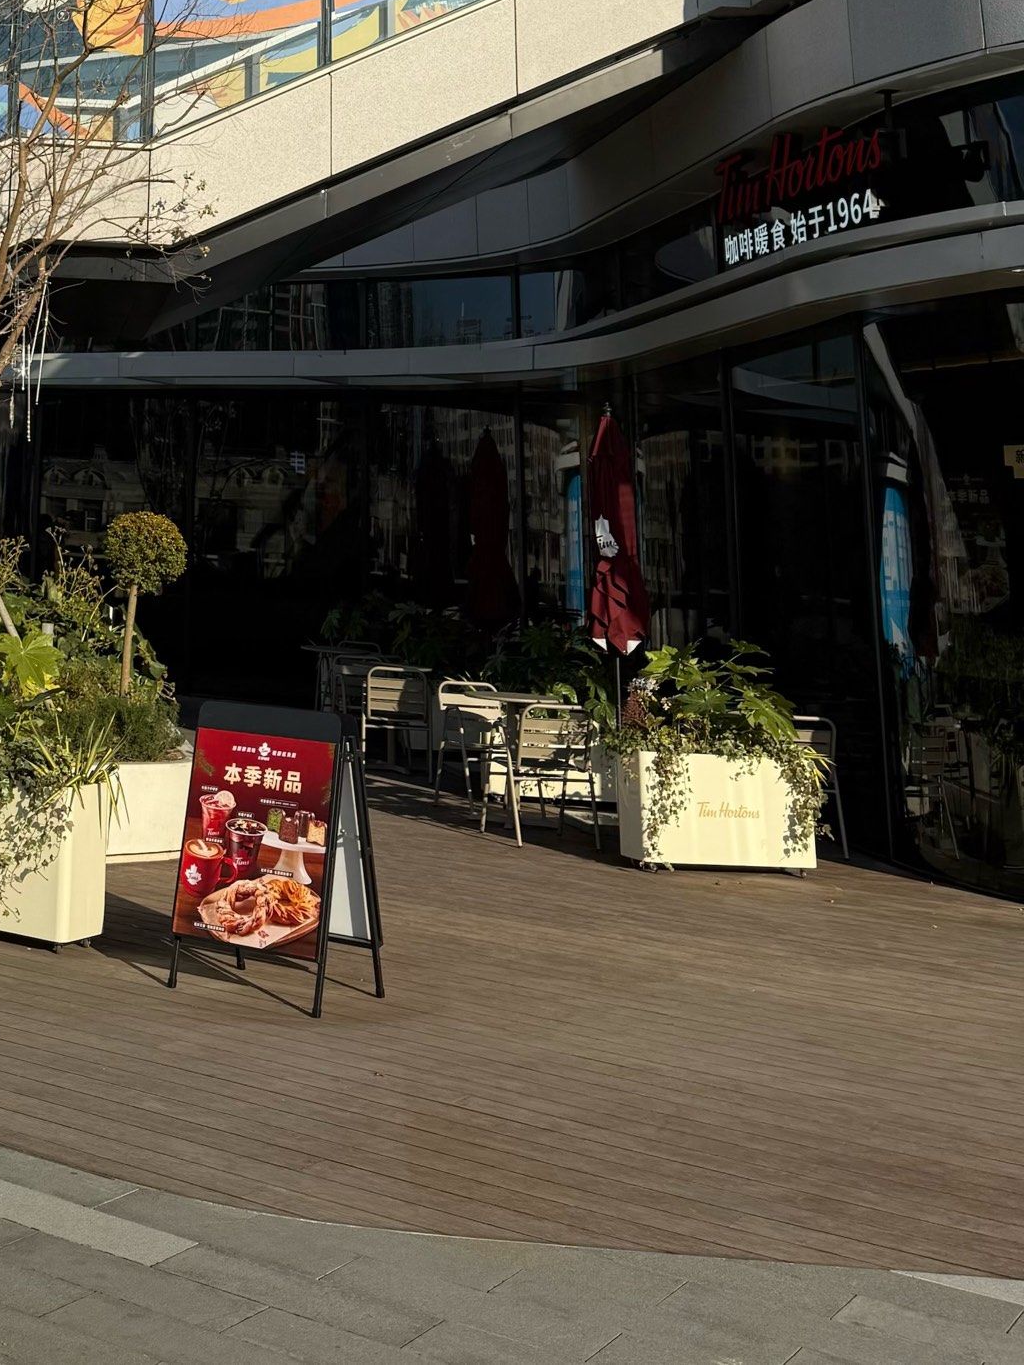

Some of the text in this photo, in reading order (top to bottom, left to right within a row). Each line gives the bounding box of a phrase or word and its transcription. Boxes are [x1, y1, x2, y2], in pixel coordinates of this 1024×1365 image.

[716, 126, 882, 223] Tim Hortons
[724, 188, 878, 264] 咖啡暖食 始于1964
[223, 762, 302, 794] 本季新品
[697, 801, 760, 819] Tim Hortons
